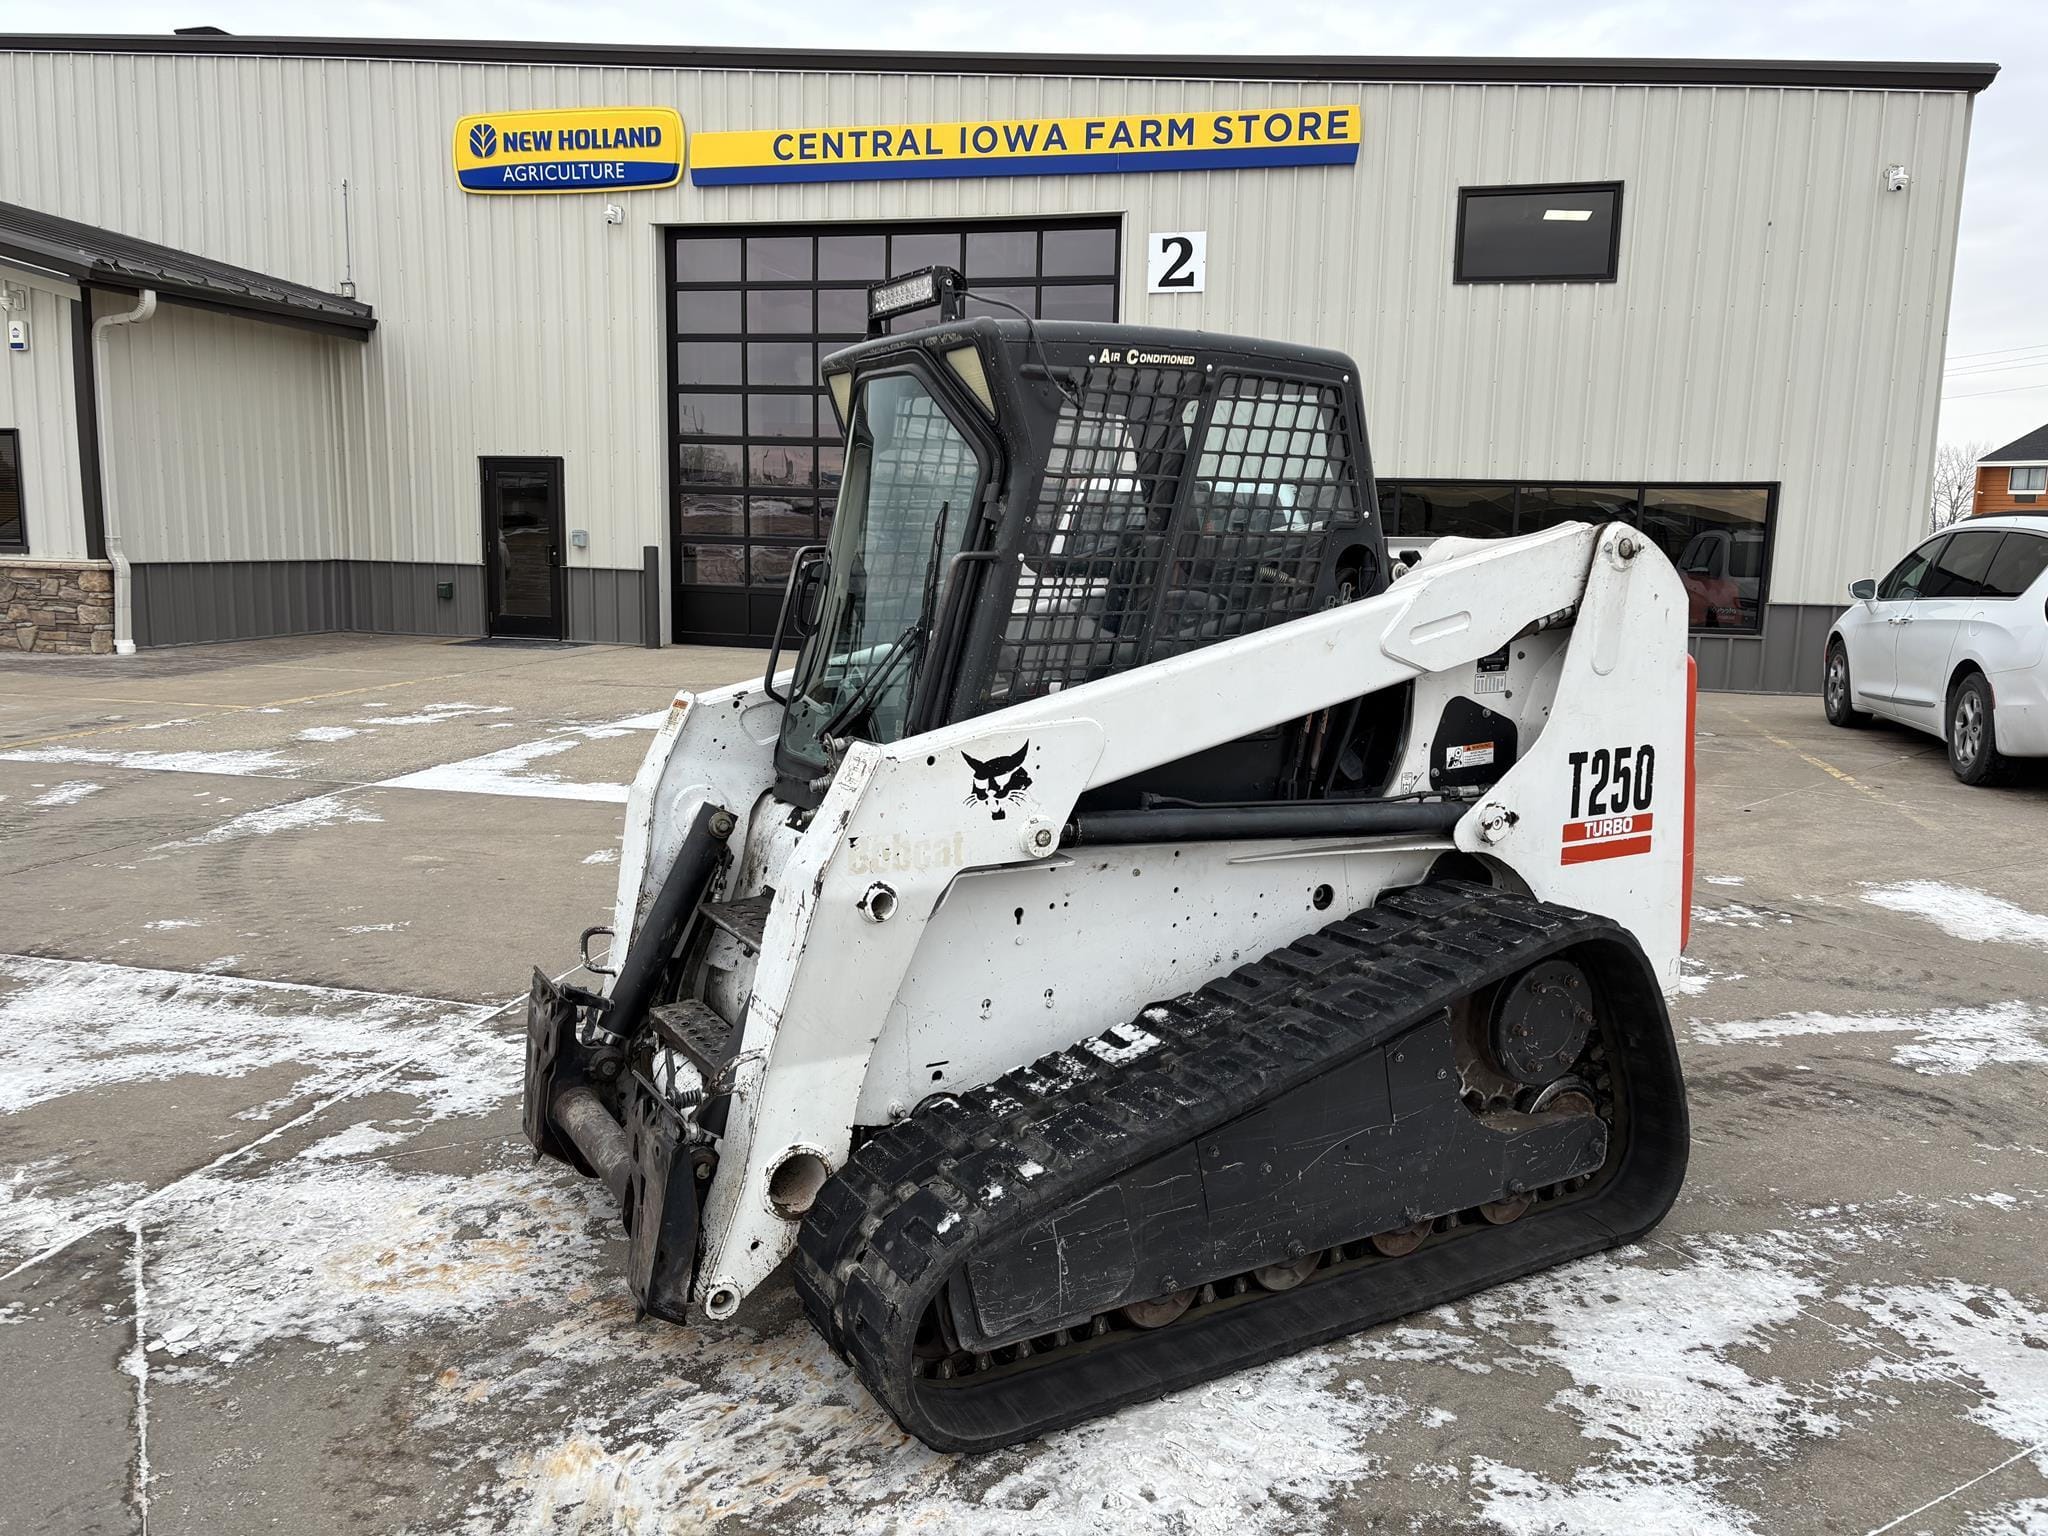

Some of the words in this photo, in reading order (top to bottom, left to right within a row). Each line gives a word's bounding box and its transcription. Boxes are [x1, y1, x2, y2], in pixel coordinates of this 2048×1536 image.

[503, 131, 552, 152] NEW
[558, 126, 662, 150] HOLLAND
[773, 127, 943, 161] CENTRAL
[960, 123, 1068, 154] IOWA
[1085, 117, 1195, 150] FARM
[1212, 109, 1350, 144] STORE
[503, 162, 625, 182] AGRICULTURE
[1157, 236, 1195, 287] 2
[1568, 744, 1656, 819] T250
[1584, 817, 1634, 839] TURBO
